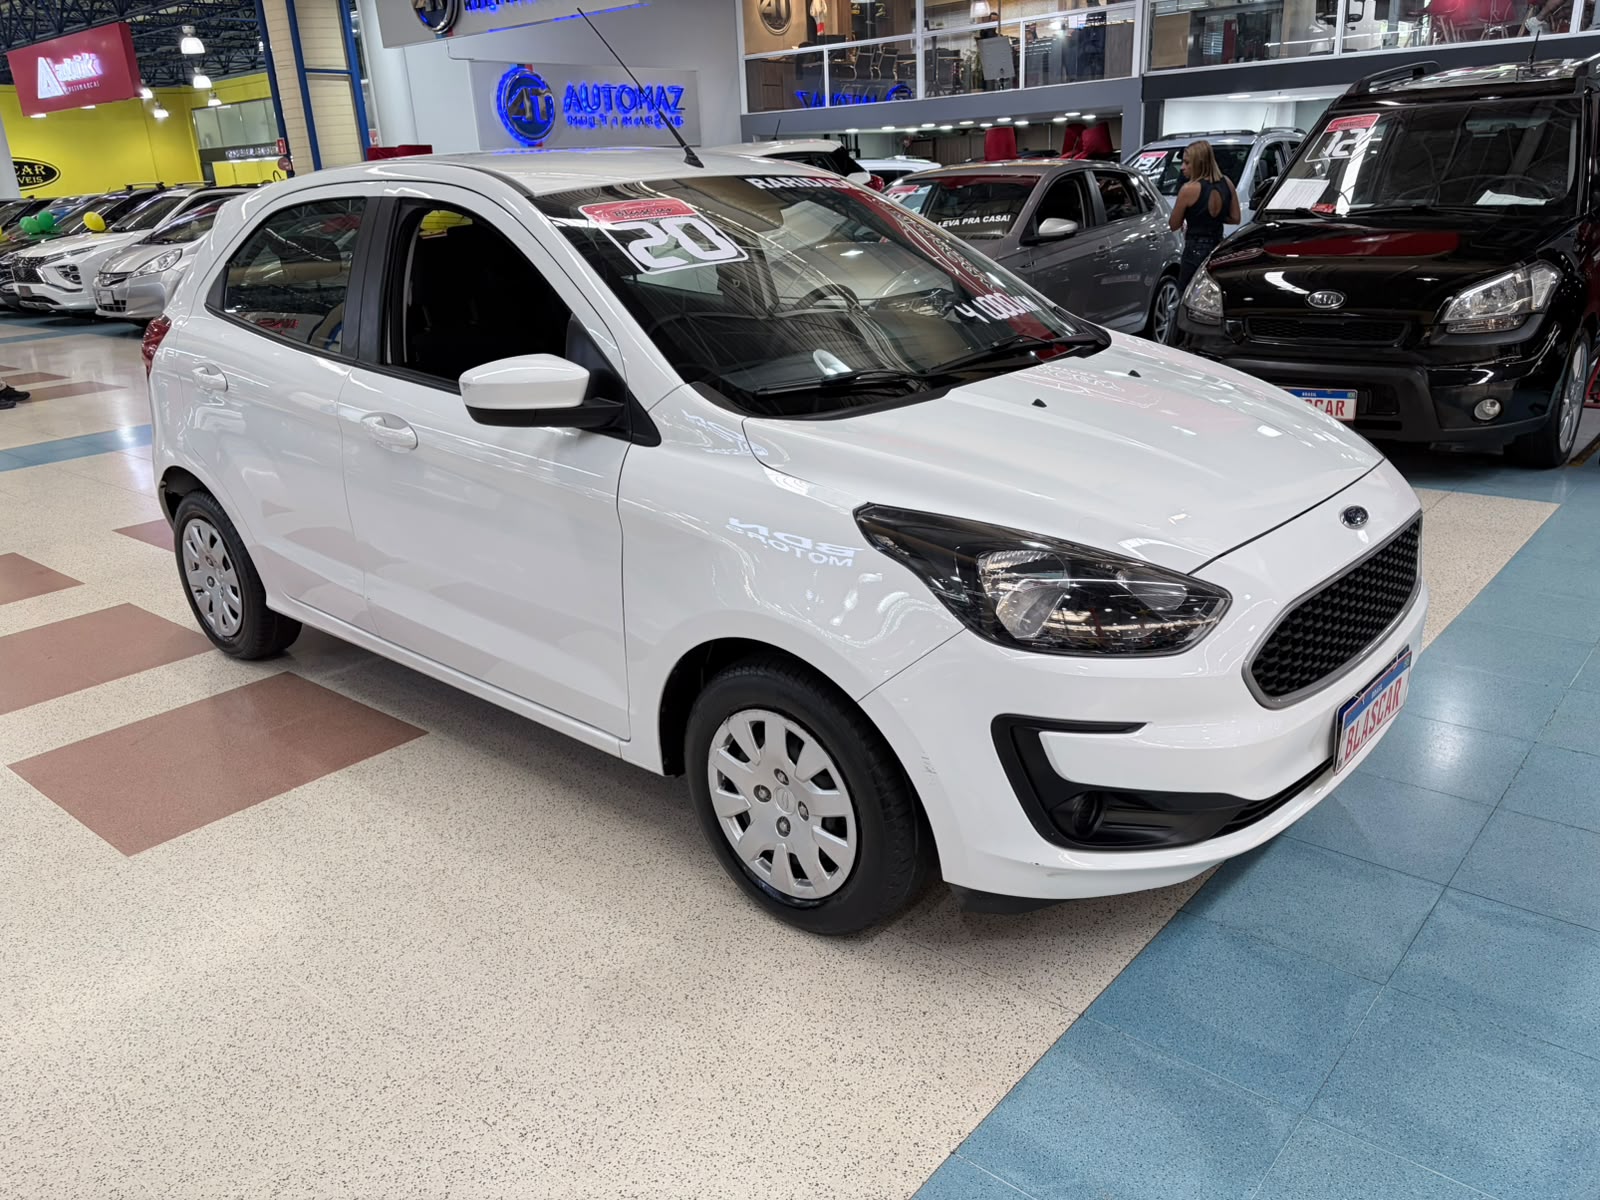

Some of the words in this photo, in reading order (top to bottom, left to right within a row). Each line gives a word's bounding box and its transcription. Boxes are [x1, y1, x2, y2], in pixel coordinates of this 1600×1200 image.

[564, 84, 686, 112] AUTOMAZ
[962, 217, 980, 225] PRA
[983, 215, 1011, 223] CASA!
[612, 217, 738, 268] 20
[1344, 677, 1403, 761] BLASCAR
